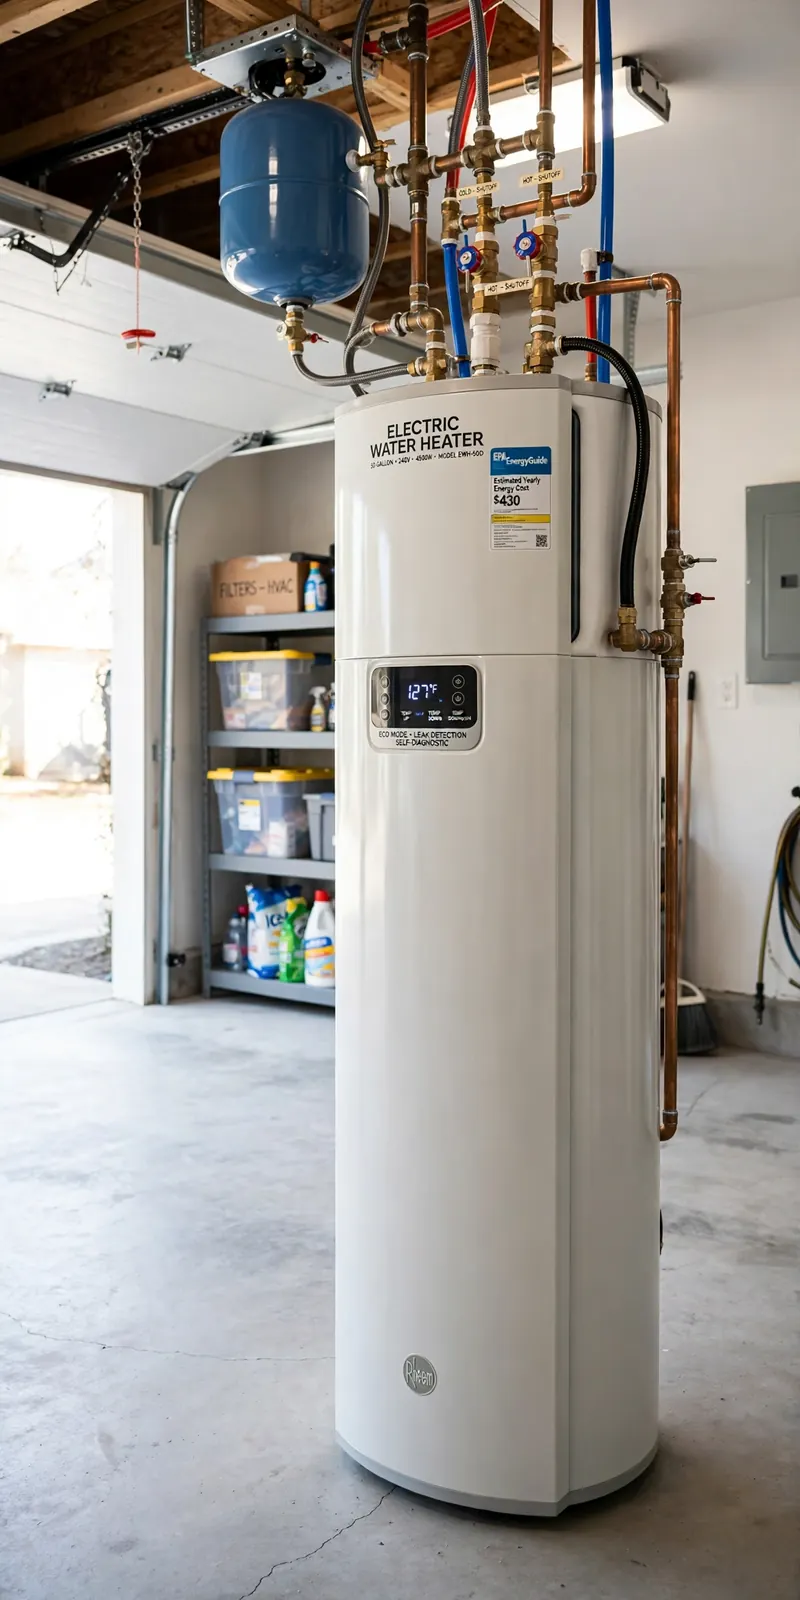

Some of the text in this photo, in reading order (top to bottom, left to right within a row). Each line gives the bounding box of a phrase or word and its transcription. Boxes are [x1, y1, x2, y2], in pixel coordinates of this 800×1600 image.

[523, 176, 534, 184] HOT
[538, 170, 561, 181] SHUTOFF
[459, 187, 471, 196] COLD
[505, 280, 530, 290] SHUTOFF
[387, 416, 460, 439] ELECTRIC
[370, 431, 484, 458] WATER HEATER
[438, 451, 457, 459] MODEL
[493, 452, 506, 461] EPA
[506, 455, 549, 467] EnergyGuide
[523, 476, 541, 485] Yearly
[493, 484, 530, 493] Energy Cost
[493, 494, 521, 506] $430
[220, 580, 257, 598] FILTERS
[267, 578, 293, 594] HVAC
[431, 731, 467, 739] DETECTION
[395, 738, 449, 746] SELF-DIAGNOSTIC
